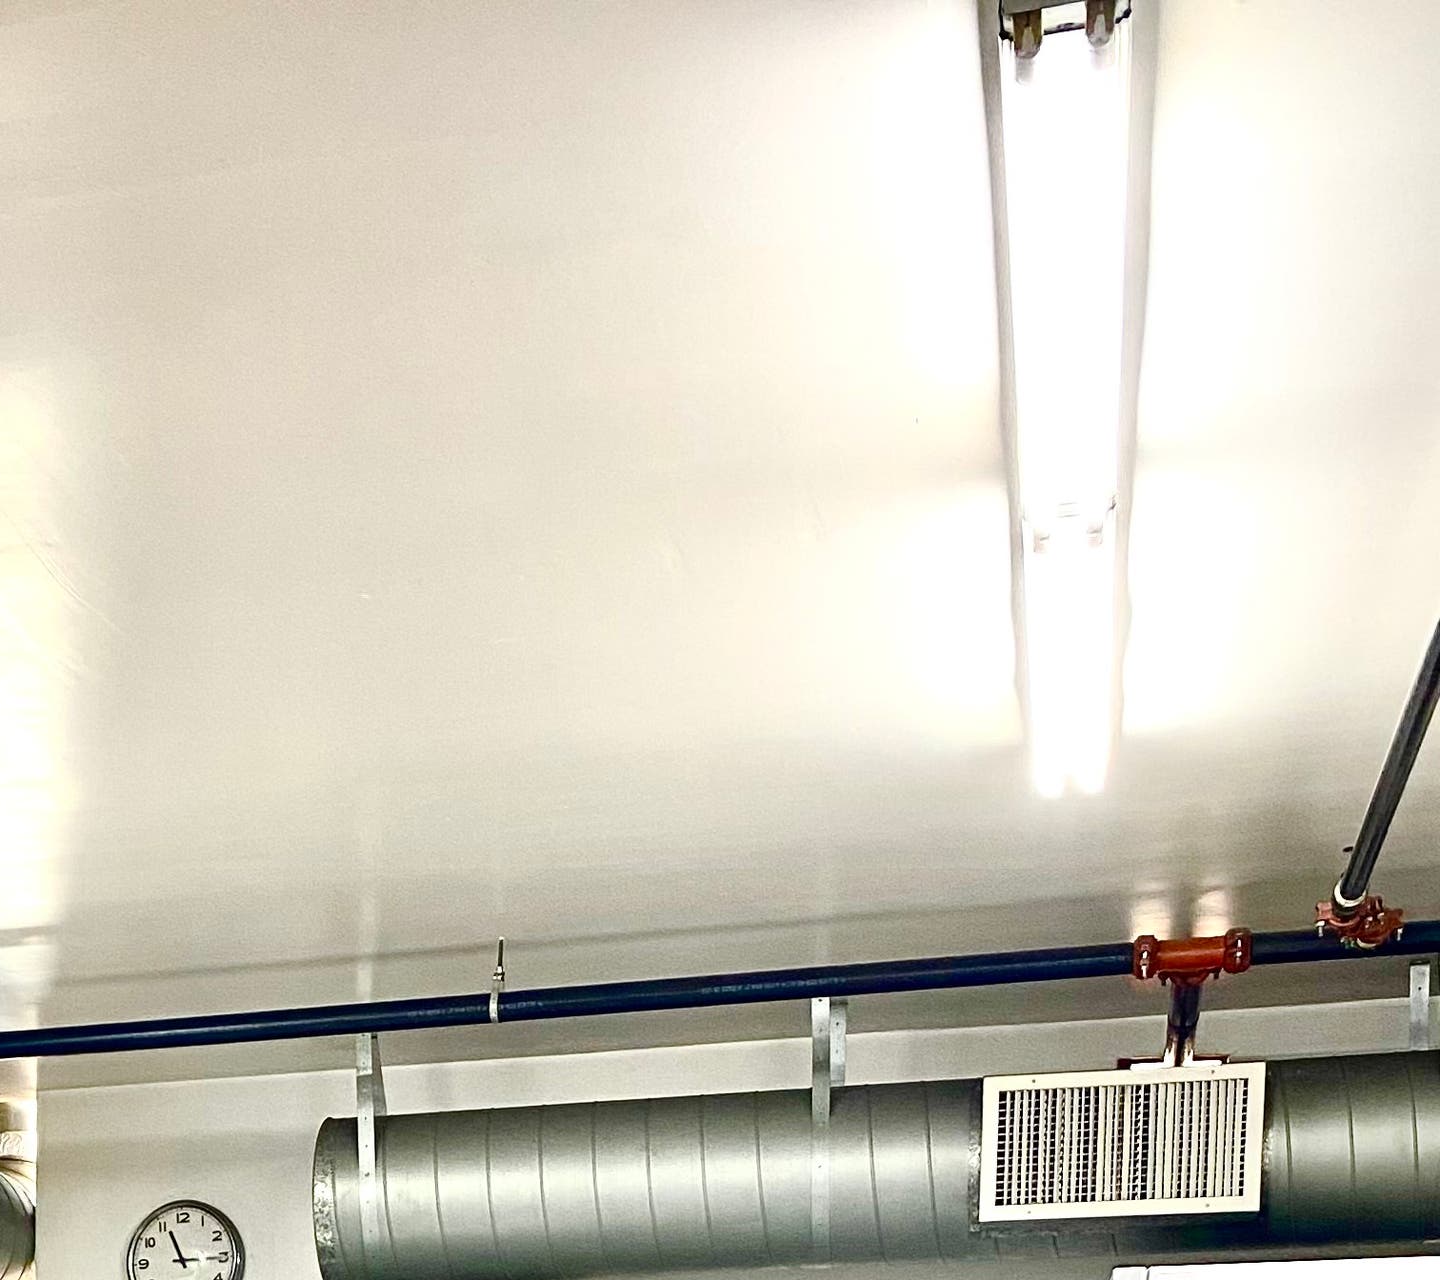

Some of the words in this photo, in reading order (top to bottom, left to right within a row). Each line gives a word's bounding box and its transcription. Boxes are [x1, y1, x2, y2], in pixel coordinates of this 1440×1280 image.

[176, 1212, 190, 1224] 12
[159, 1221, 166, 1233] 11
[212, 1230, 223, 1242] 2
[145, 1237, 156, 1248] 10
[218, 1251, 229, 1263] 3
[138, 1259, 149, 1269] 9
